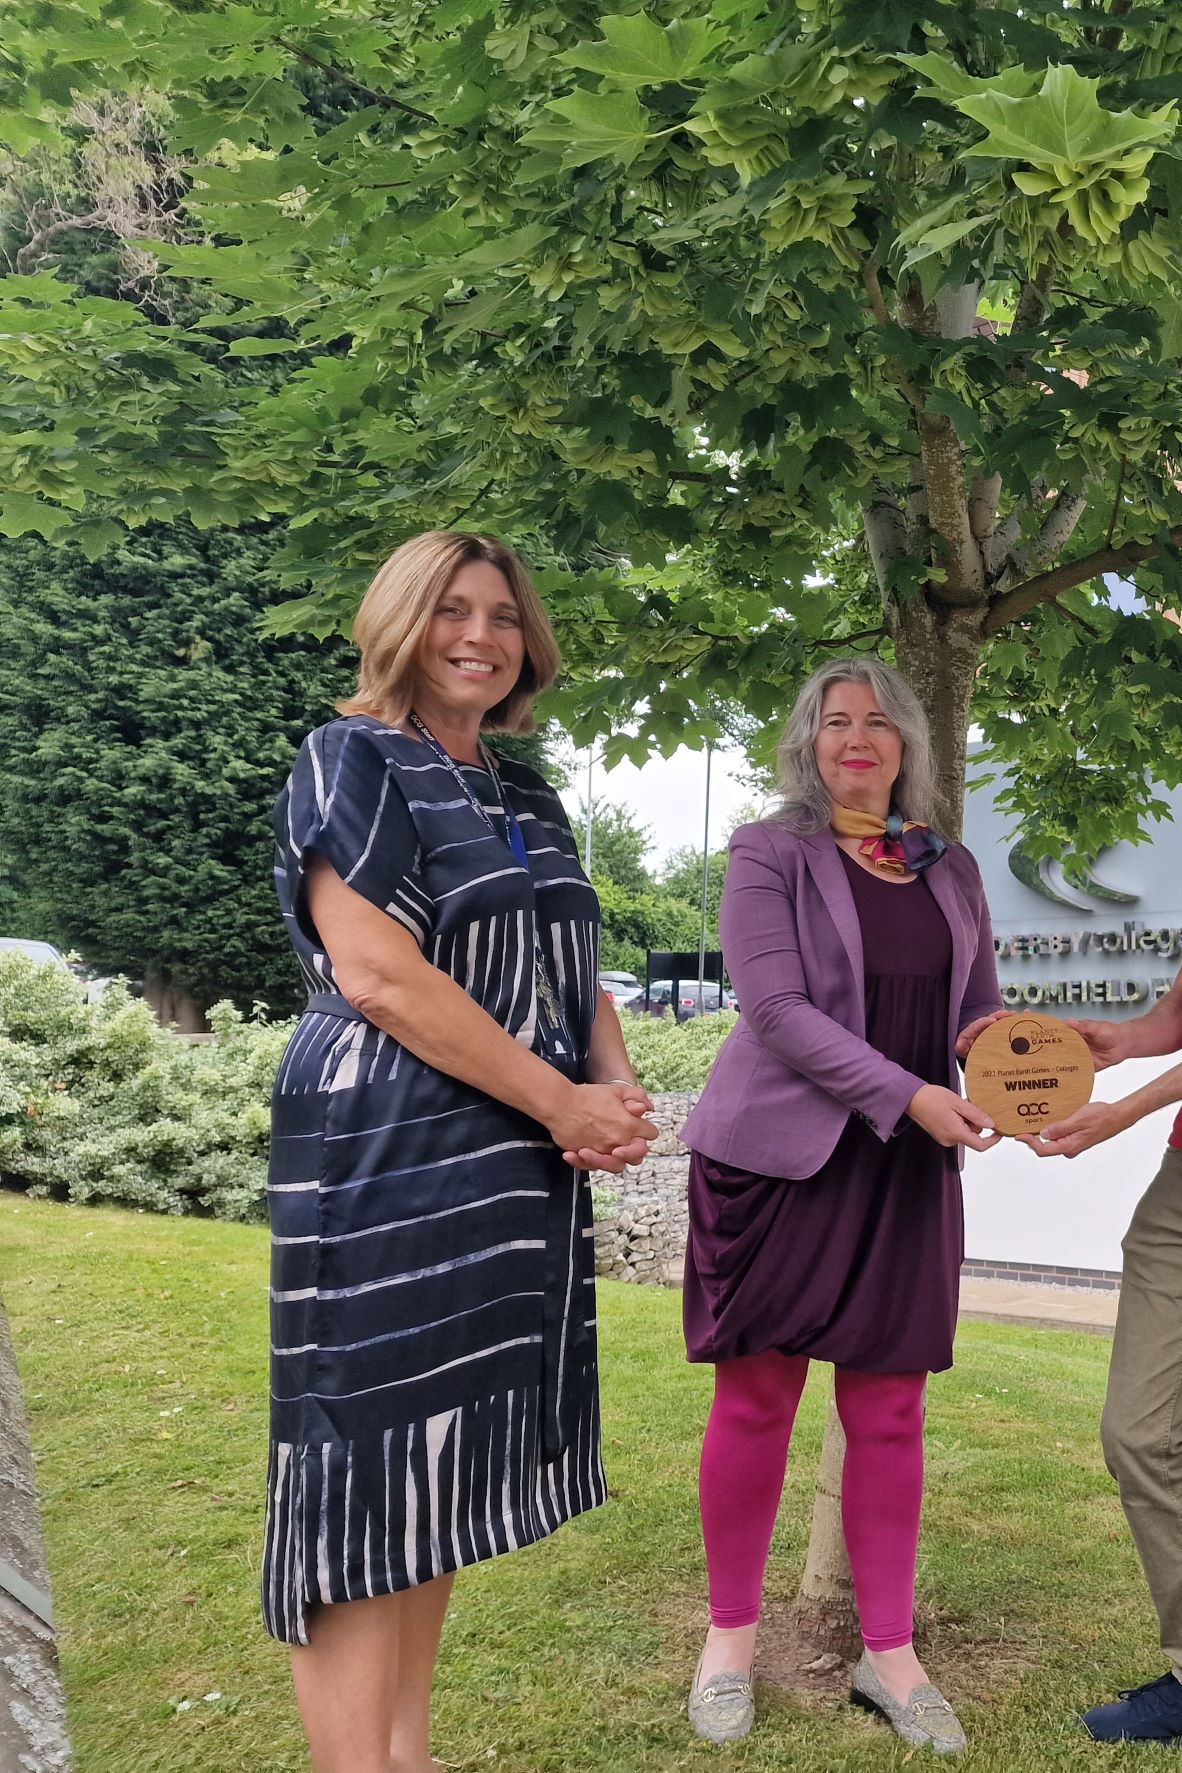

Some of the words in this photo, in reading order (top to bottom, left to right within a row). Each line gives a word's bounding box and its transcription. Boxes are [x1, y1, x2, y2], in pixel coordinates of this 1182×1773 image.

[1002, 978, 1149, 1005] OOMFIELD
[997, 1069, 1015, 1077] Planet
[1015, 1067, 1031, 1076] Earth
[1031, 1066, 1050, 1074] Games
[1055, 1065, 1079, 1074] Colleges
[1004, 1078, 1059, 1092] WINNER
